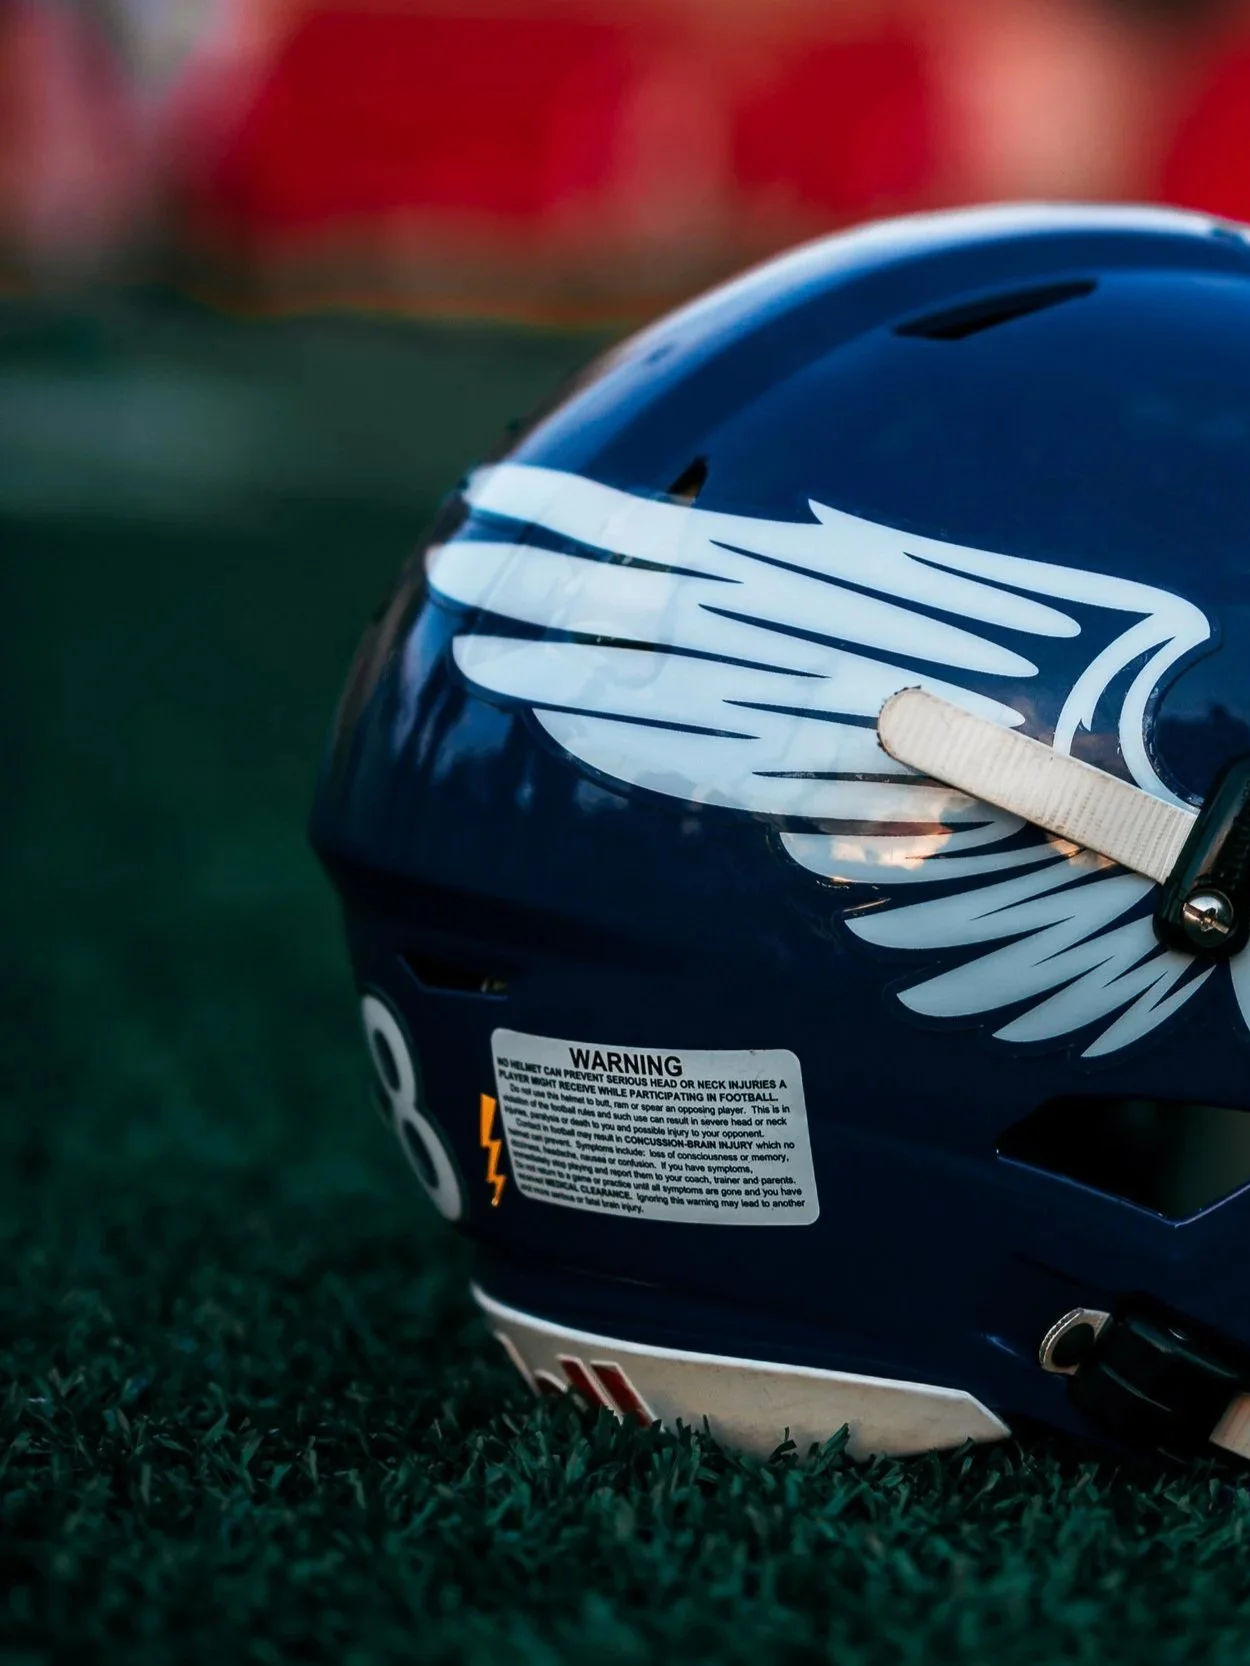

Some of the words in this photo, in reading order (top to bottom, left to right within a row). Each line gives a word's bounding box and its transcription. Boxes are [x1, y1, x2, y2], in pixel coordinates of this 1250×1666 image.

[569, 1047, 683, 1077] WARNING
[510, 1060, 541, 1073] HELMET
[543, 1066, 561, 1077] CAN
[563, 1069, 604, 1082] PREVENT
[606, 1075, 648, 1086] SERIOUS
[650, 1078, 677, 1088] HEAD
[680, 1080, 695, 1089] OR
[697, 1080, 726, 1089] NECK
[728, 1080, 776, 1089] INJURIES
[779, 1080, 787, 1088] A
[498, 1069, 529, 1083] PLAYER
[531, 1076, 556, 1088] MIGHT
[559, 1081, 596, 1094] RECEIVE
[597, 1086, 627, 1097] WHILE
[629, 1089, 703, 1101] PARTICIPATING
[706, 1093, 716, 1102] IN
[720, 1093, 778, 1102] FOOTBALL.
[361, 995, 462, 1221] 8
[595, 1098, 612, 1108] butt,
[641, 1104, 663, 1112] spear
[677, 1106, 715, 1115] opposing
[718, 1106, 746, 1115] player.
[751, 1105, 770, 1114] This
[772, 1105, 780, 1113] is
[782, 1105, 790, 1113] in
[597, 1111, 611, 1119] and
[613, 1113, 631, 1121] such
[666, 1117, 689, 1125] result
[691, 1117, 698, 1125] in
[731, 1118, 752, 1126] head
[766, 1117, 787, 1125] neck
[592, 1121, 600, 1129] to
[600, 1123, 615, 1131] you
[616, 1124, 631, 1132] and
[633, 1127, 665, 1135] possible
[667, 1128, 689, 1138] injury
[691, 1129, 699, 1137] to
[722, 1130, 764, 1139] opponent.
[593, 1133, 614, 1142] result
[624, 1135, 716, 1149] CONCUSSION-BRAIN
[719, 1141, 753, 1149] INJURY
[756, 1141, 781, 1149] which
[575, 1140, 614, 1153] Symptoms
[615, 1146, 646, 1156] include:
[649, 1149, 665, 1158] loss
[667, 1151, 675, 1159] of
[677, 1152, 738, 1161] consciousness
[751, 1154, 789, 1163] memory,
[617, 1159, 656, 1168] confusion.
[668, 1164, 683, 1172] you
[685, 1163, 705, 1172] have
[707, 1165, 753, 1174] symptoms,
[595, 1167, 608, 1175] and
[610, 1169, 632, 1177] report
[633, 1171, 654, 1179] them
[684, 1176, 711, 1184] coach,
[713, 1176, 740, 1184] trainer
[742, 1176, 759, 1184] and
[761, 1176, 796, 1186] parents.
[580, 1185, 633, 1200] CLEARANCE.
[636, 1193, 669, 1205] Ignoring
[669, 1197, 684, 1205] this
[686, 1198, 719, 1208] warning
[721, 1200, 739, 1209] may
[740, 1199, 760, 1207] lead
[772, 1199, 805, 1207] another
[602, 1179, 632, 1189] practice
[662, 1186, 703, 1195] symptoms
[720, 1189, 742, 1197] gone
[744, 1188, 760, 1196] and
[762, 1189, 778, 1198] you
[780, 1187, 802, 1195] have
